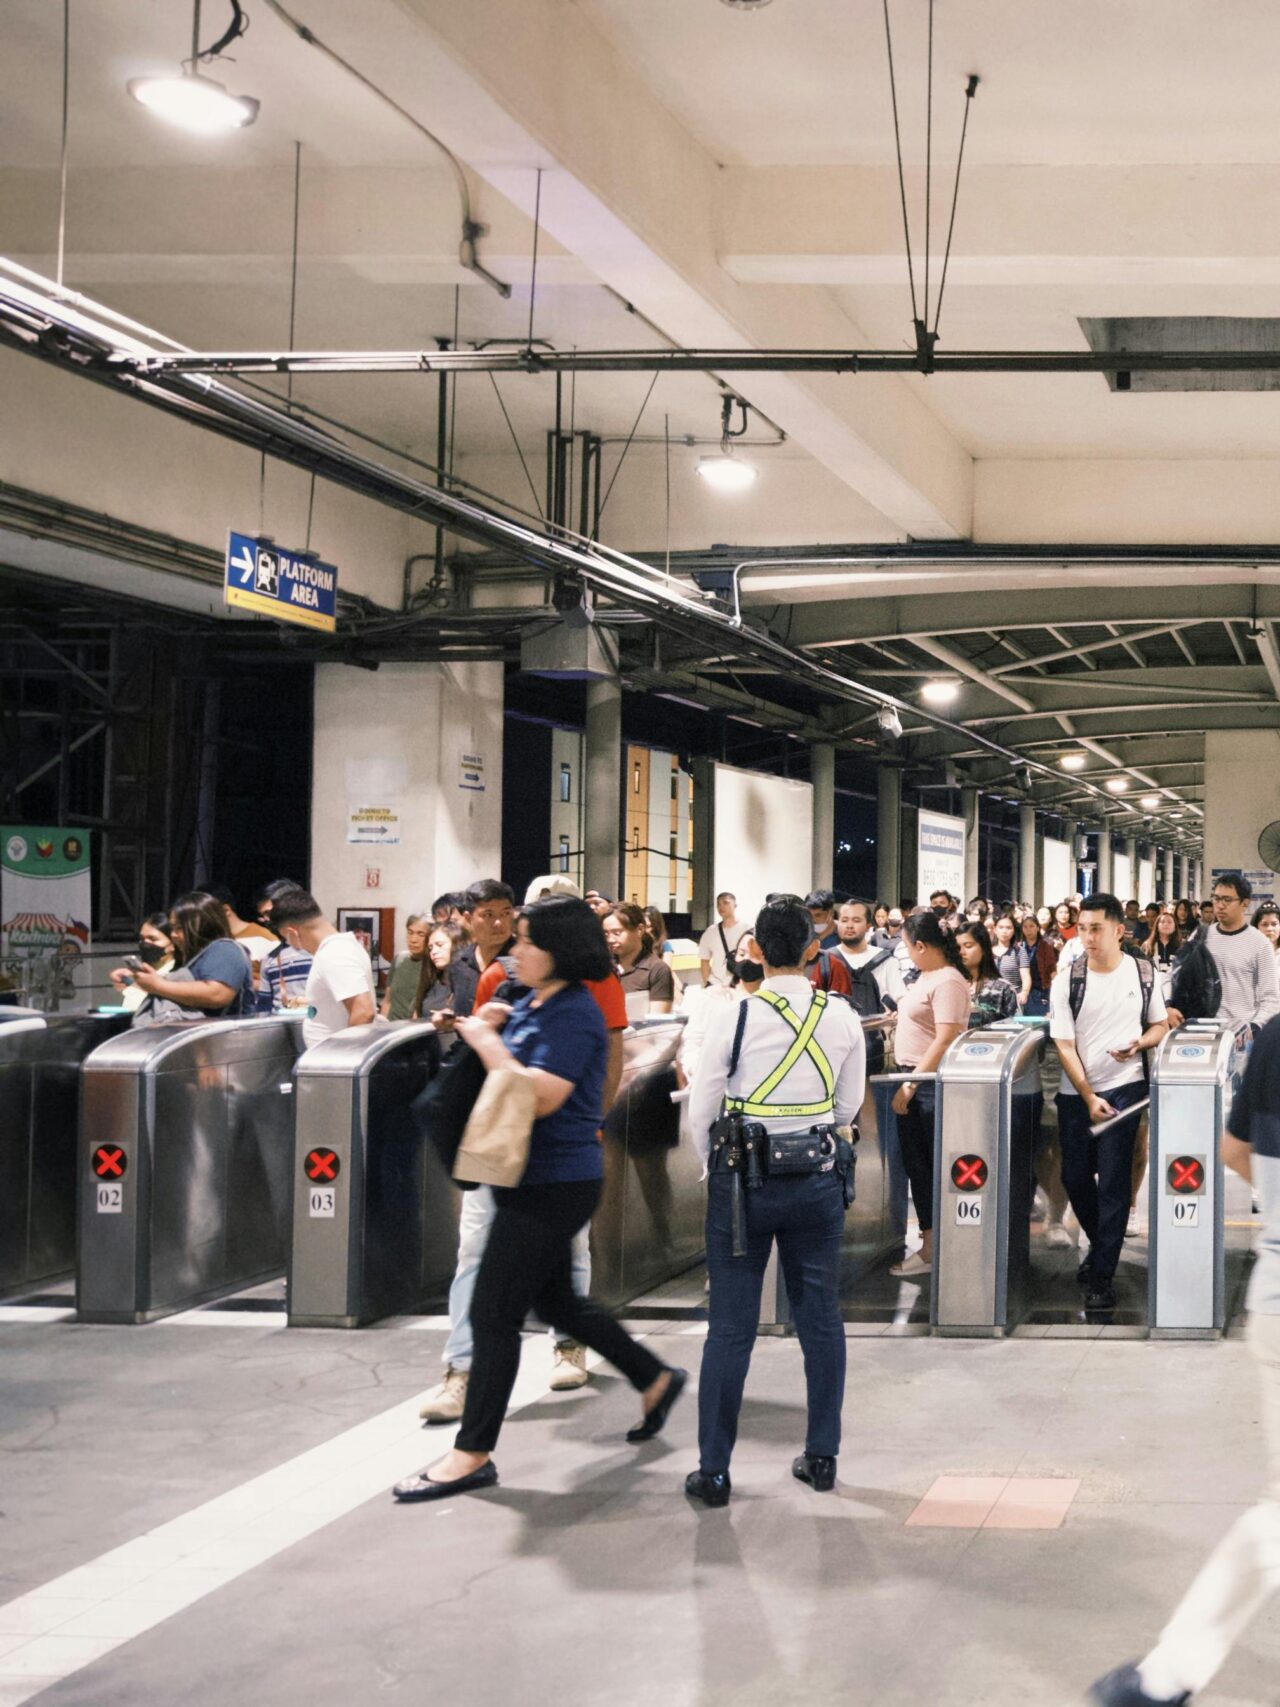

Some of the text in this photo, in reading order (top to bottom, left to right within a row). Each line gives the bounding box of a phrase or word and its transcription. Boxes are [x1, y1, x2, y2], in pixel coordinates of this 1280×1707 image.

[280, 557, 334, 592] PLATFORM
[290, 583, 319, 608] AREA
[99, 1190, 120, 1206] 02
[312, 1194, 333, 1211] 03
[958, 1201, 981, 1219] 06
[1174, 1203, 1197, 1220] 07
